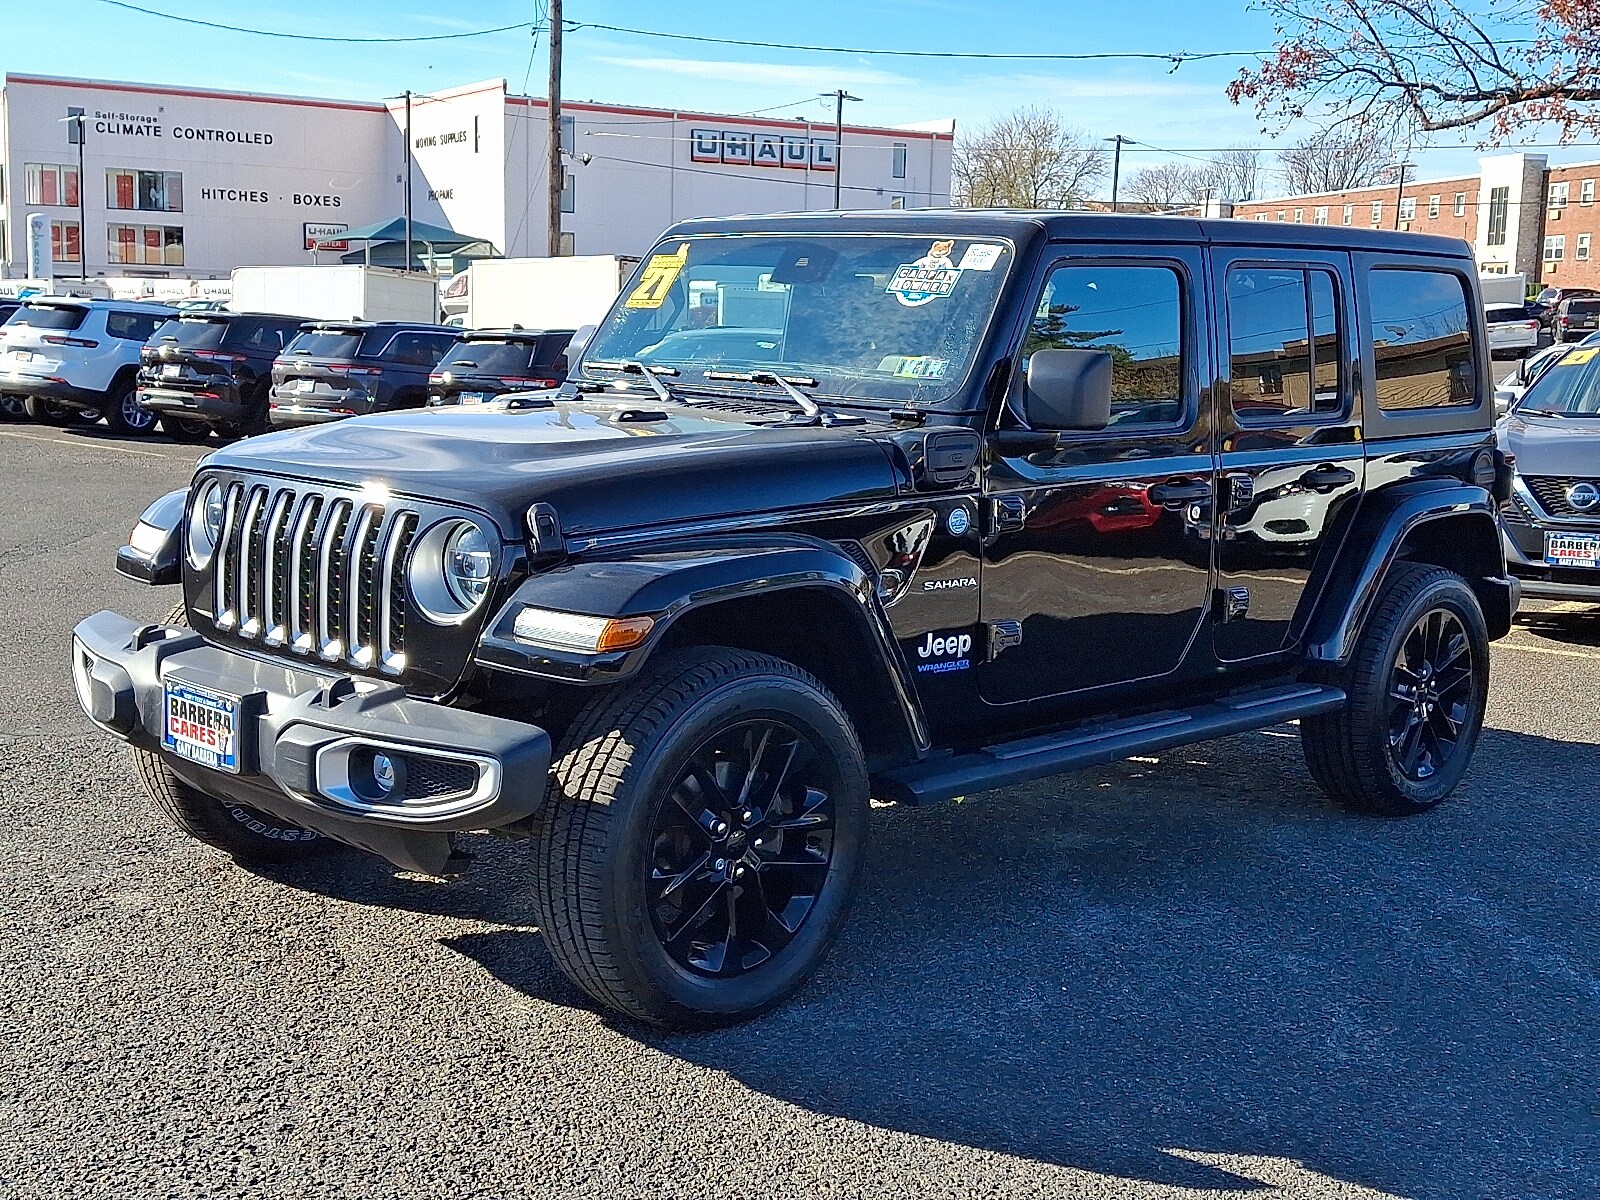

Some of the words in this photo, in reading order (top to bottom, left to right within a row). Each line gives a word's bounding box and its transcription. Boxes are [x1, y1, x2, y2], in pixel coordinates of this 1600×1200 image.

[95, 111, 158, 123] Self-Storage
[95, 122, 162, 137] CLIMATE
[173, 127, 273, 145] CONTROLLED
[416, 135, 437, 148] MOVING
[440, 130, 467, 145] SUPPLIES
[201, 188, 269, 203] HITCHES
[293, 193, 341, 207] BOXES
[898, 268, 954, 281] CARFAX
[1550, 549, 1592, 558] CARES
[923, 577, 978, 591] SAHARA
[918, 632, 971, 658] Jeep
[917, 659, 970, 672] WRANGLER
[170, 697, 232, 735] BARBERA
[170, 717, 216, 746] CARES
